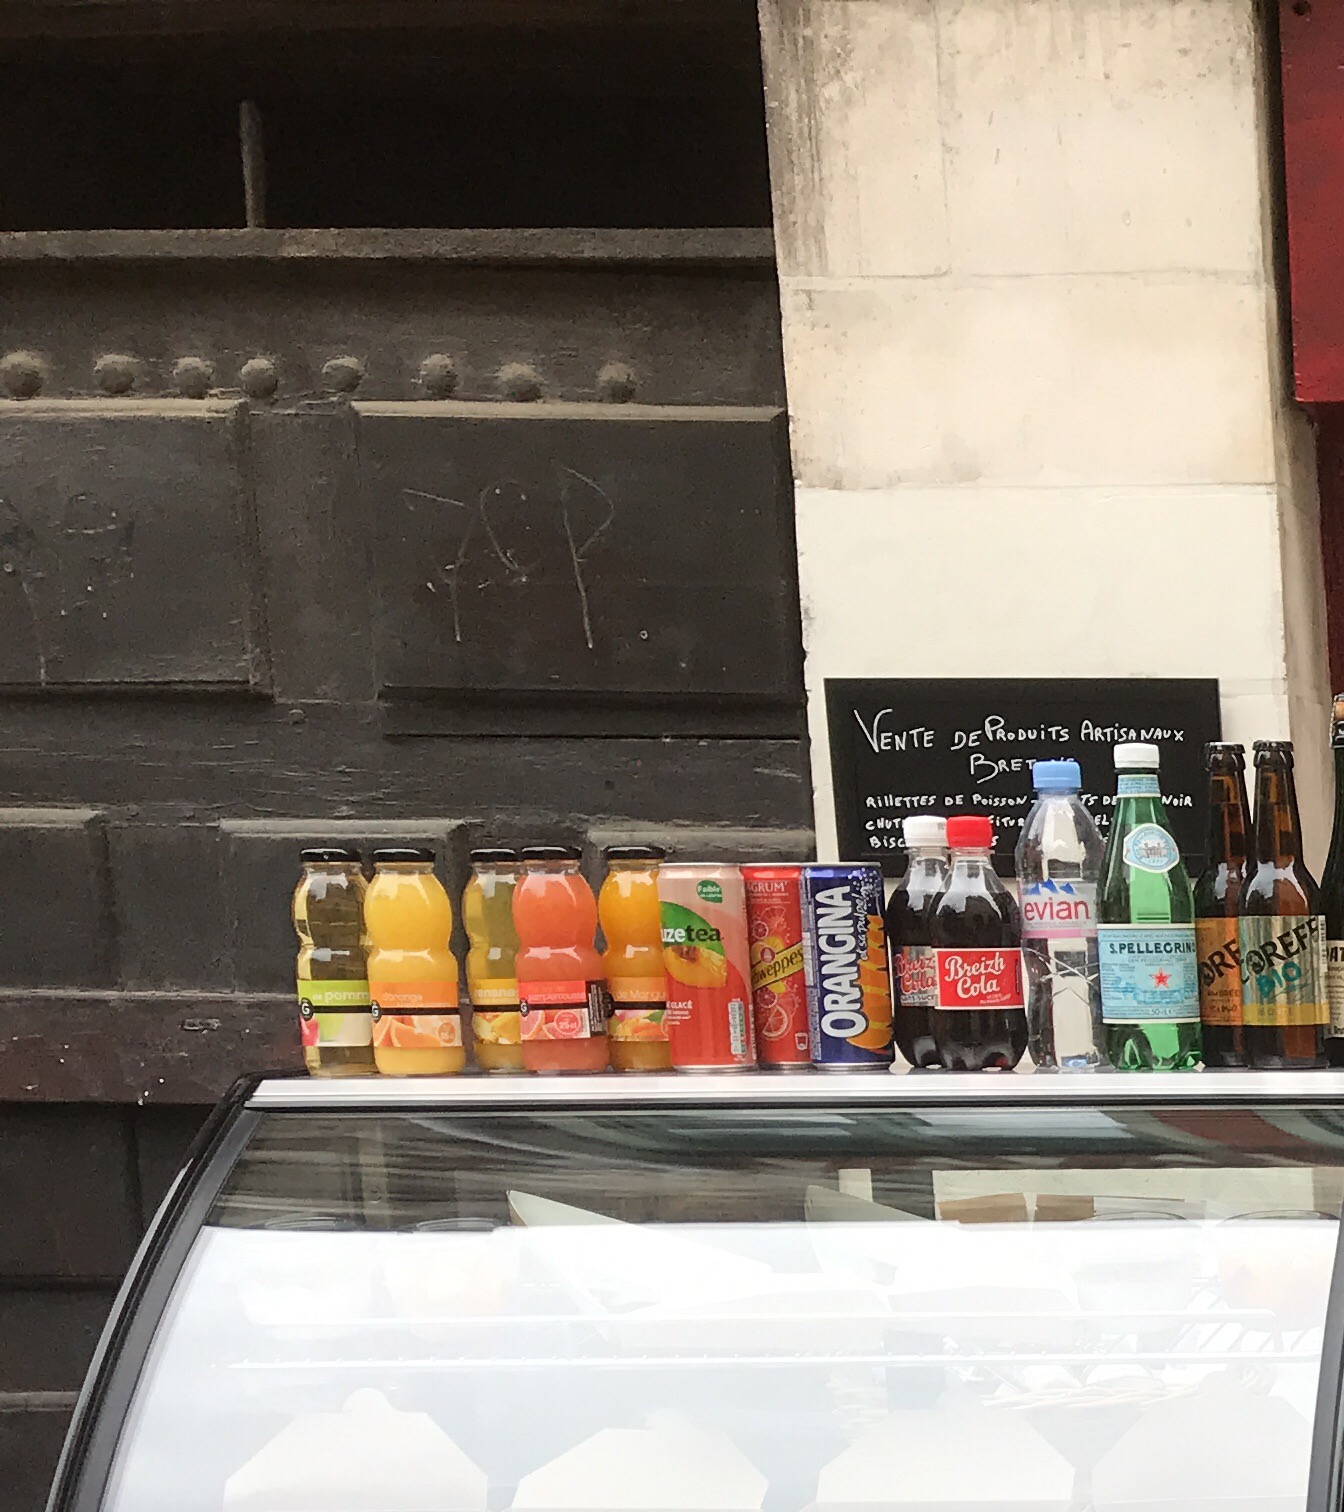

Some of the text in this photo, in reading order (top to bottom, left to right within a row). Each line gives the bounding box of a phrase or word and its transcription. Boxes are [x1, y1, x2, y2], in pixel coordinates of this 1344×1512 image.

[950, 730, 982, 751] DE
[944, 794, 964, 806] DE
[1024, 897, 1091, 922] evian
[815, 885, 867, 1038] ORANGINA
[944, 951, 1005, 982] Breizh
[324, 990, 369, 1003] pomm
[957, 975, 1000, 998] Cola
